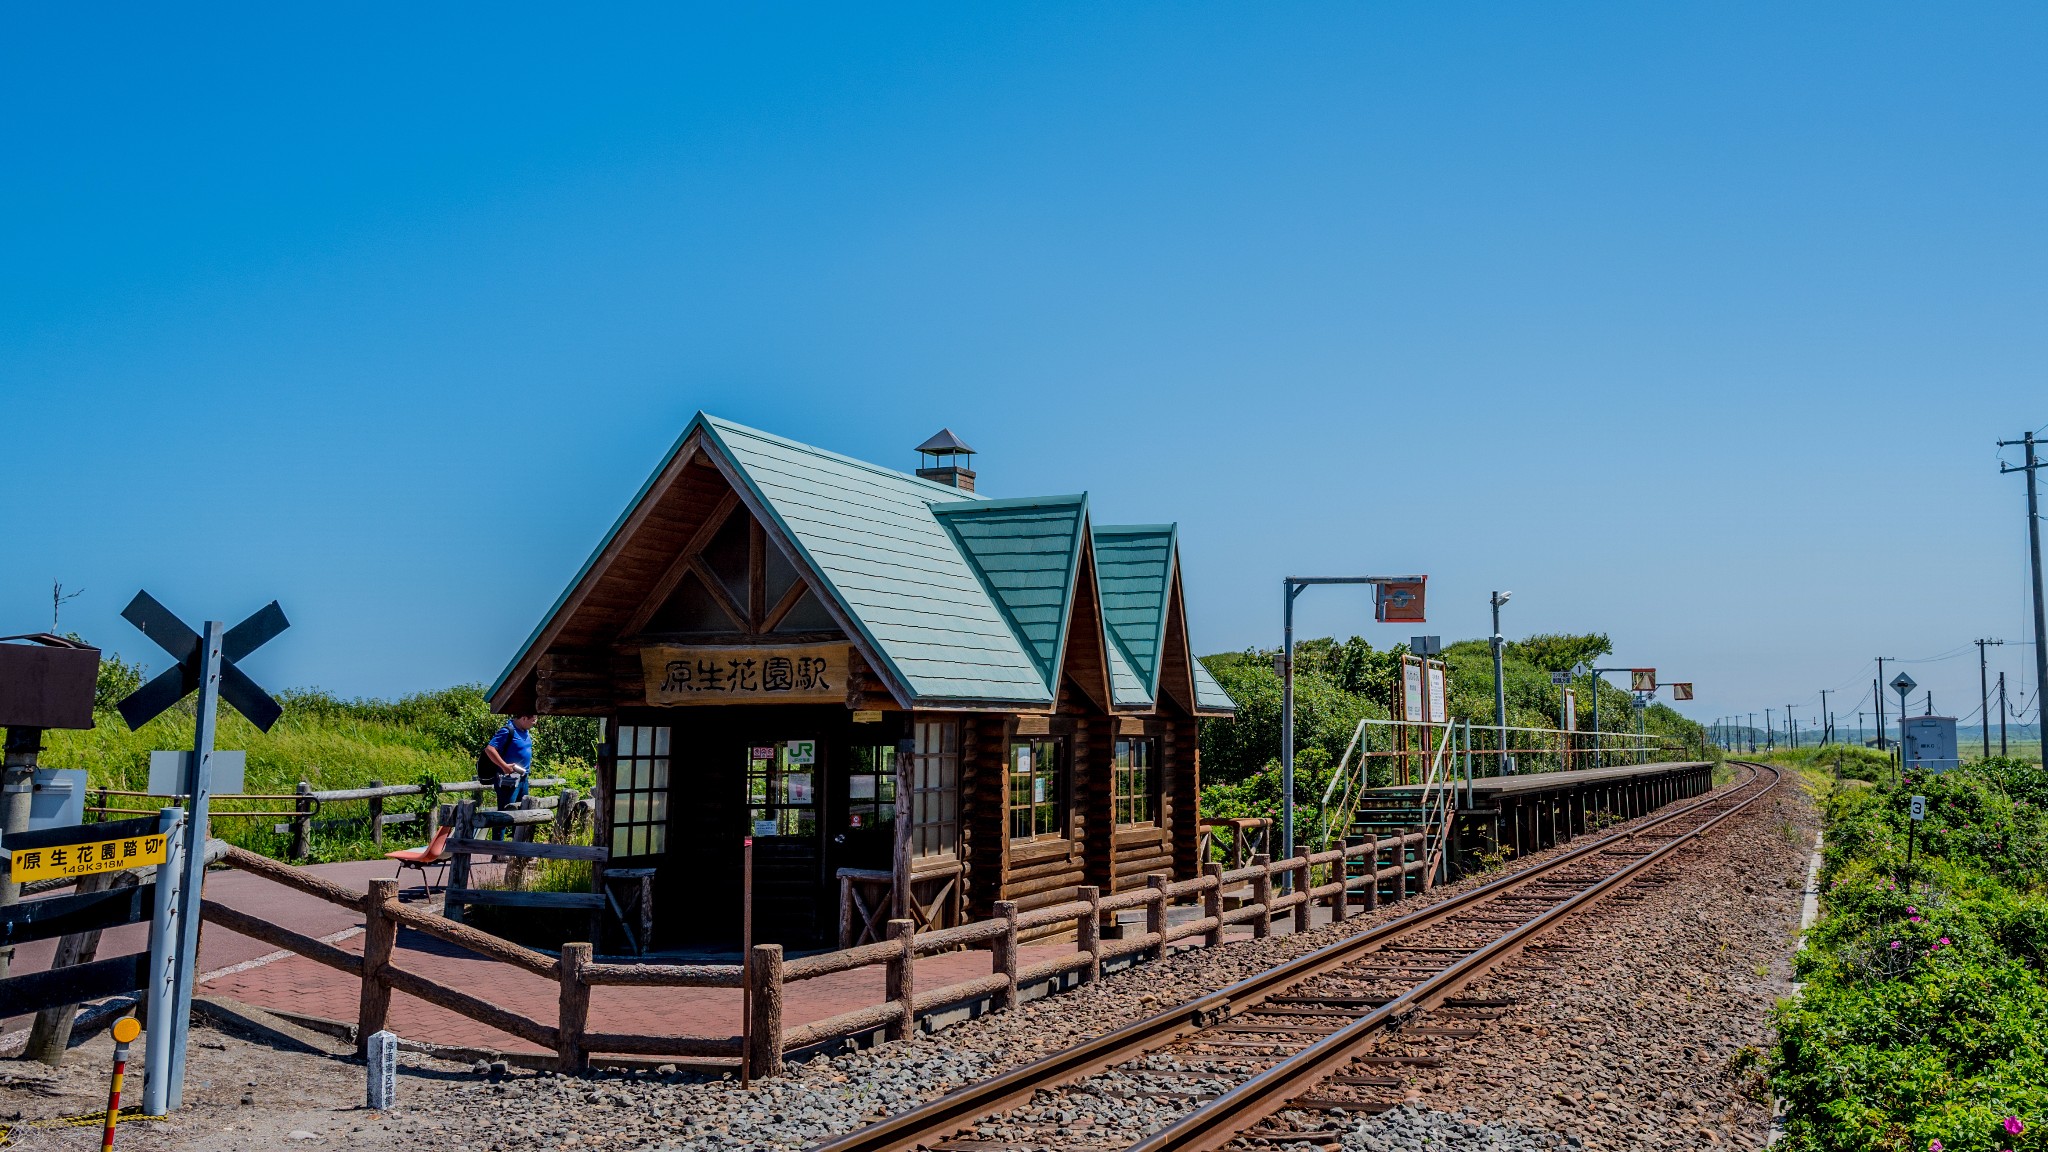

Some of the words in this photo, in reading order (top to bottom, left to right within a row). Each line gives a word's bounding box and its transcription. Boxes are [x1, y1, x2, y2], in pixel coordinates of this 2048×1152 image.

[661, 656, 830, 693] 原生花園駅
[1577, 665, 1582, 674] 1
[1647, 692, 1653, 700] 2
[789, 742, 813, 757] JR
[1912, 802, 1922, 815] 3
[22, 838, 159, 870] 原生花園踏切
[62, 859, 124, 875] 149K318M
